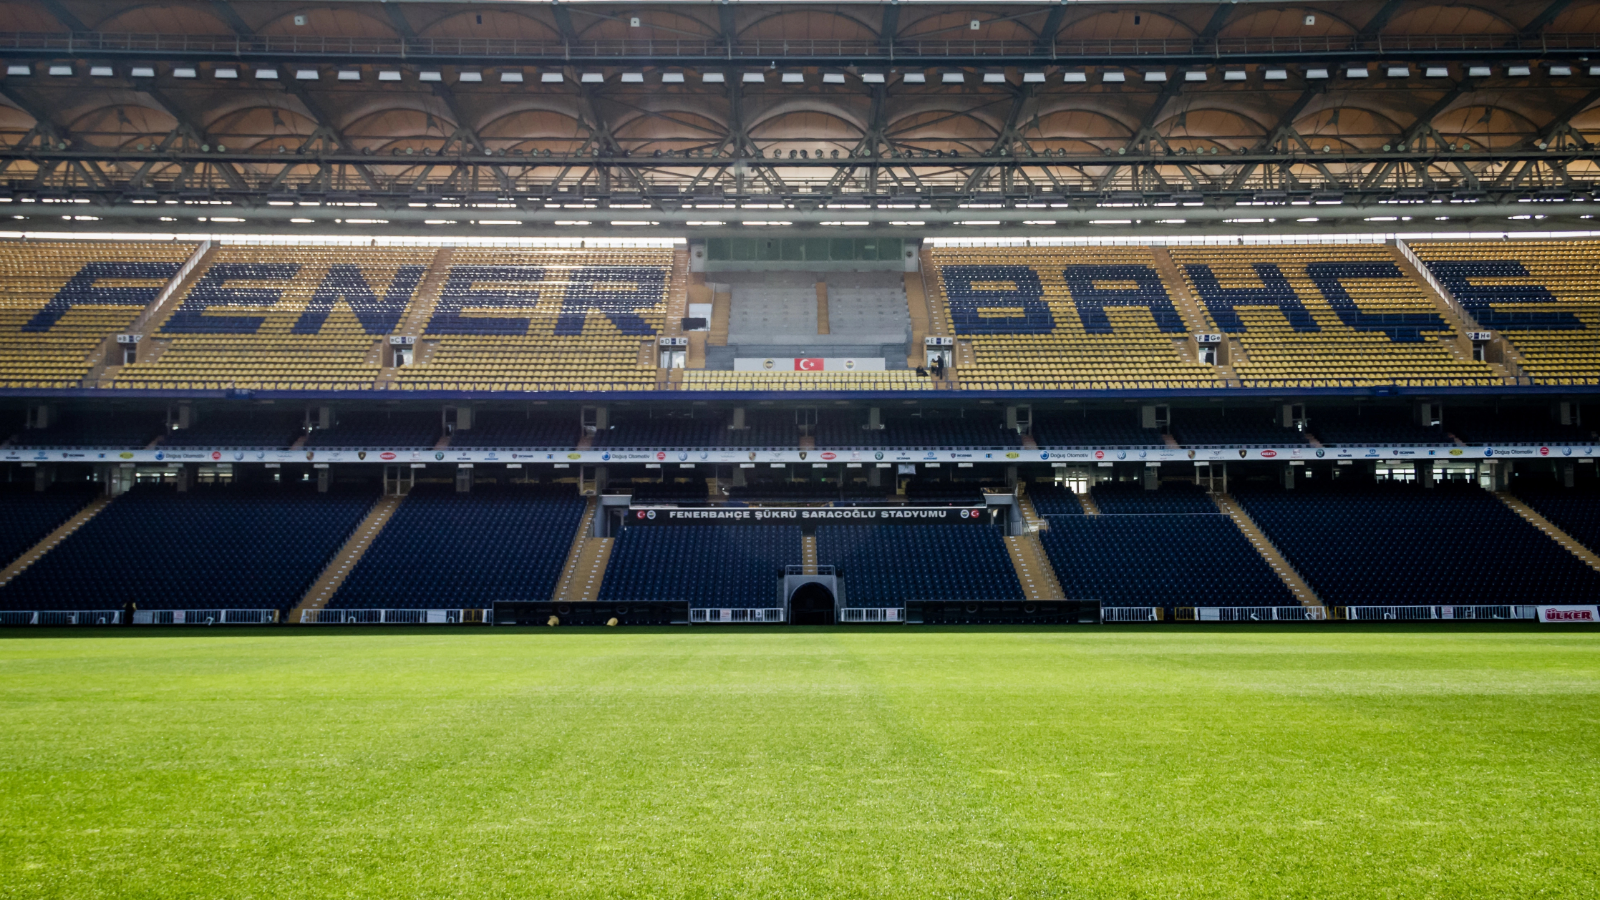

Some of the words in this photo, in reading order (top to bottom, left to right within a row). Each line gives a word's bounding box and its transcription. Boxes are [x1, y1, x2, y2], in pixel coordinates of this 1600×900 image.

[22, 261, 668, 336] FENER
[942, 262, 1585, 342] BAHÇE
[669, 510, 751, 520] FENERBAHÇE
[754, 509, 798, 520] ŞÜKRÜ
[801, 509, 877, 518] SARACOĞLU
[880, 510, 947, 518] STADYUMU
[1545, 608, 1594, 622] ÜLKER
